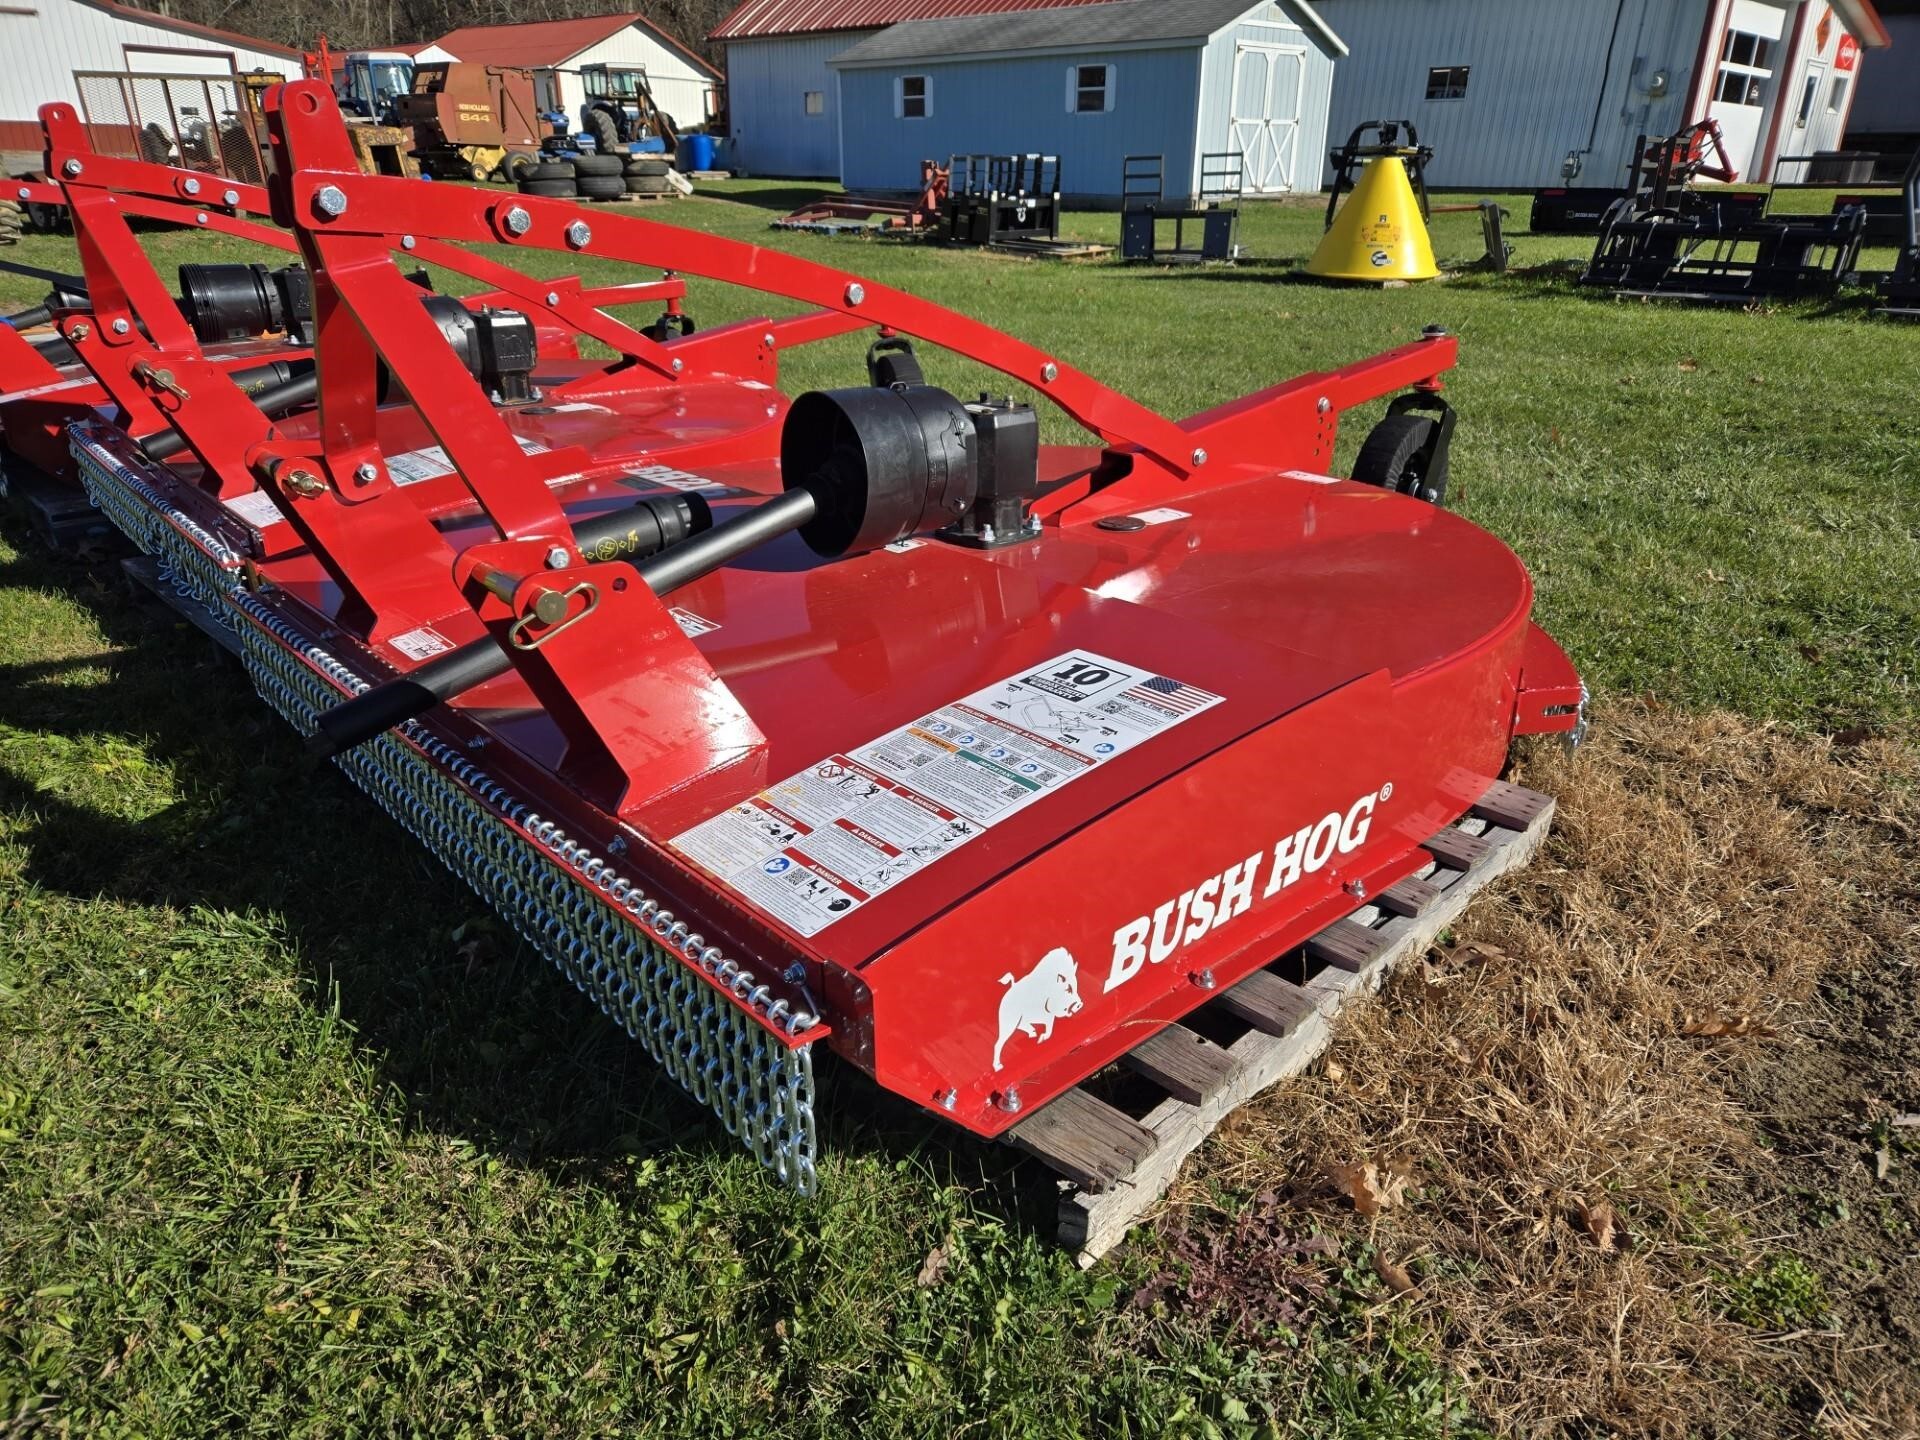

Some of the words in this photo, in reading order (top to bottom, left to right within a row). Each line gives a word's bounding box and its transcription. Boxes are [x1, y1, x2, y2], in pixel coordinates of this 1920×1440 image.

[460, 113, 490, 122] 644
[1052, 664, 1110, 685] 10
[1163, 709, 1180, 718] USA
[878, 756, 906, 770] WARNING
[978, 761, 1016, 779] IMPORTANT
[853, 767, 878, 780] DANGER
[913, 797, 941, 812] DANGER
[772, 810, 797, 825] DANGER
[858, 831, 885, 847] DANGER
[816, 867, 842, 885] DANGER
[1103, 851, 1263, 994] BUSH
[1263, 791, 1378, 899] HOG
